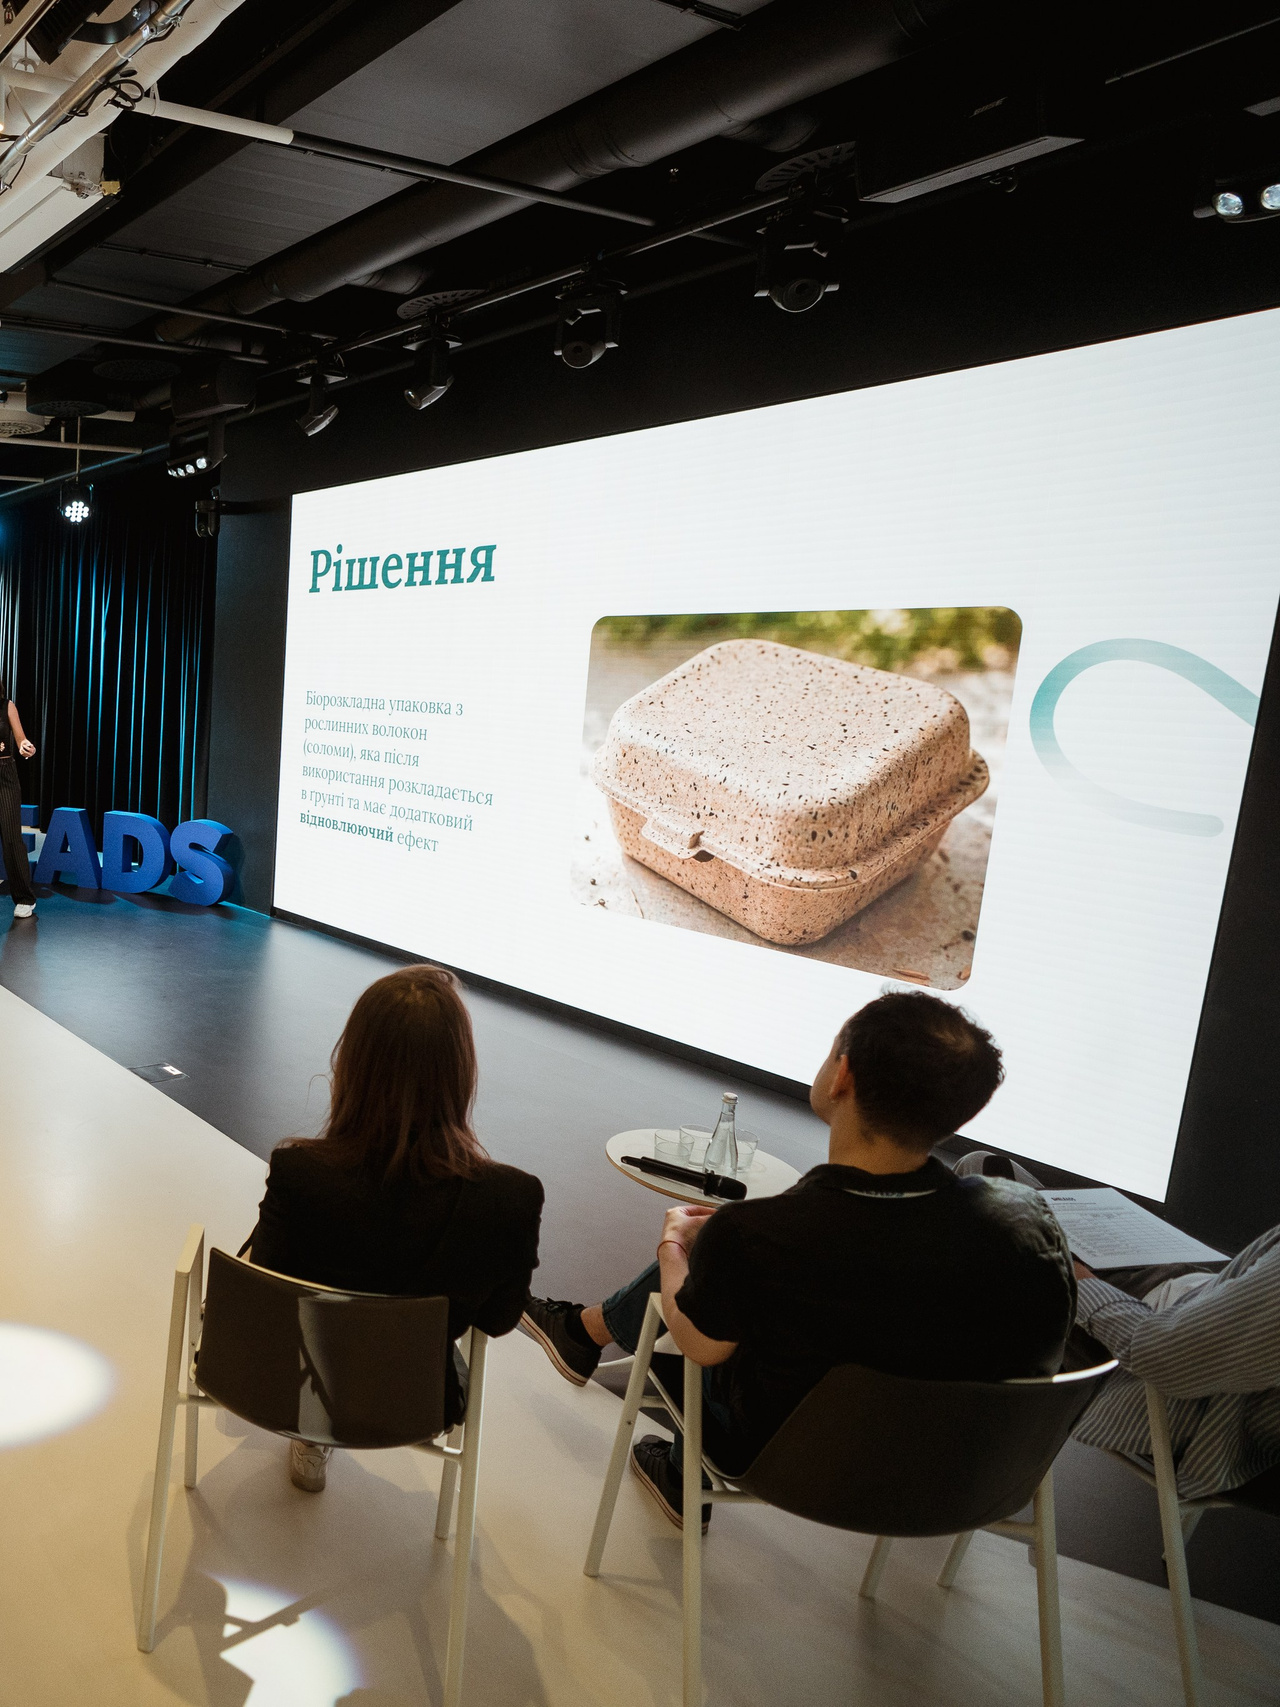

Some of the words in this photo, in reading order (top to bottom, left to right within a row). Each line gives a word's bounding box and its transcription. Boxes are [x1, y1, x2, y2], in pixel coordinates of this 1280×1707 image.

[309, 544, 497, 593] Рішення
[306, 690, 385, 711] Біорозкладна
[388, 699, 451, 716] упаковка
[455, 703, 463, 716] з
[304, 718, 369, 735] рослинних
[372, 724, 428, 741] волокон
[303, 739, 357, 763] (соломи),
[359, 748, 380, 762] яка
[384, 748, 420, 767] після
[302, 765, 385, 789] використання
[388, 778, 494, 806] розкладається
[301, 789, 307, 800] в
[347, 796, 360, 810] та
[363, 800, 387, 815] має
[389, 804, 474, 831] додатковий
[300, 810, 394, 842] відновлюючий
[397, 830, 439, 852] ефект
